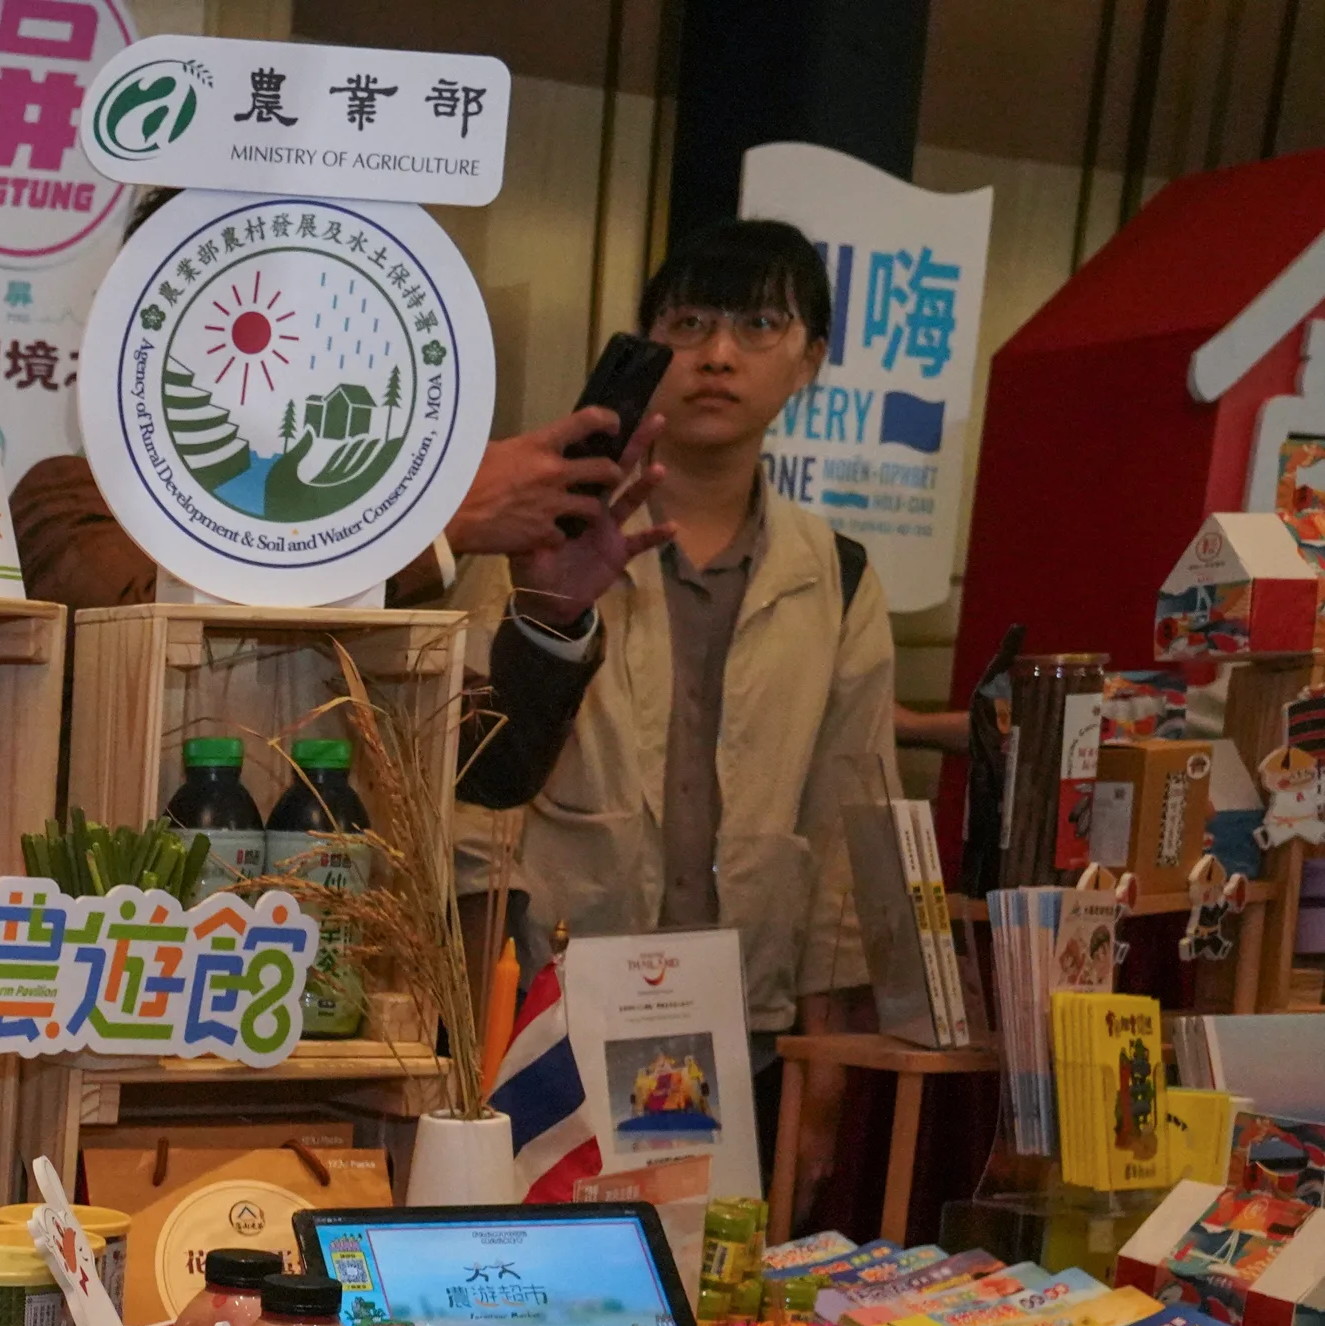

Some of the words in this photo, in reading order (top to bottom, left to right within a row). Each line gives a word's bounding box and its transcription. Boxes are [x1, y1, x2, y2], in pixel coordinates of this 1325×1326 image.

[234, 68, 487, 138] 農業部
[230, 143, 318, 168] MINISTRY
[322, 147, 348, 168] OF
[350, 151, 481, 177] AGRICULTURE
[158, 213, 439, 334] 農業部農村發展及水土保持署
[864, 246, 961, 380] 嗨
[157, 464, 241, 540] Development
[256, 534, 286, 552] Soil
[288, 534, 317, 552] and
[317, 519, 364, 550] Water
[425, 373, 443, 421] MOA
[14, 983, 58, 999] Pavilion
